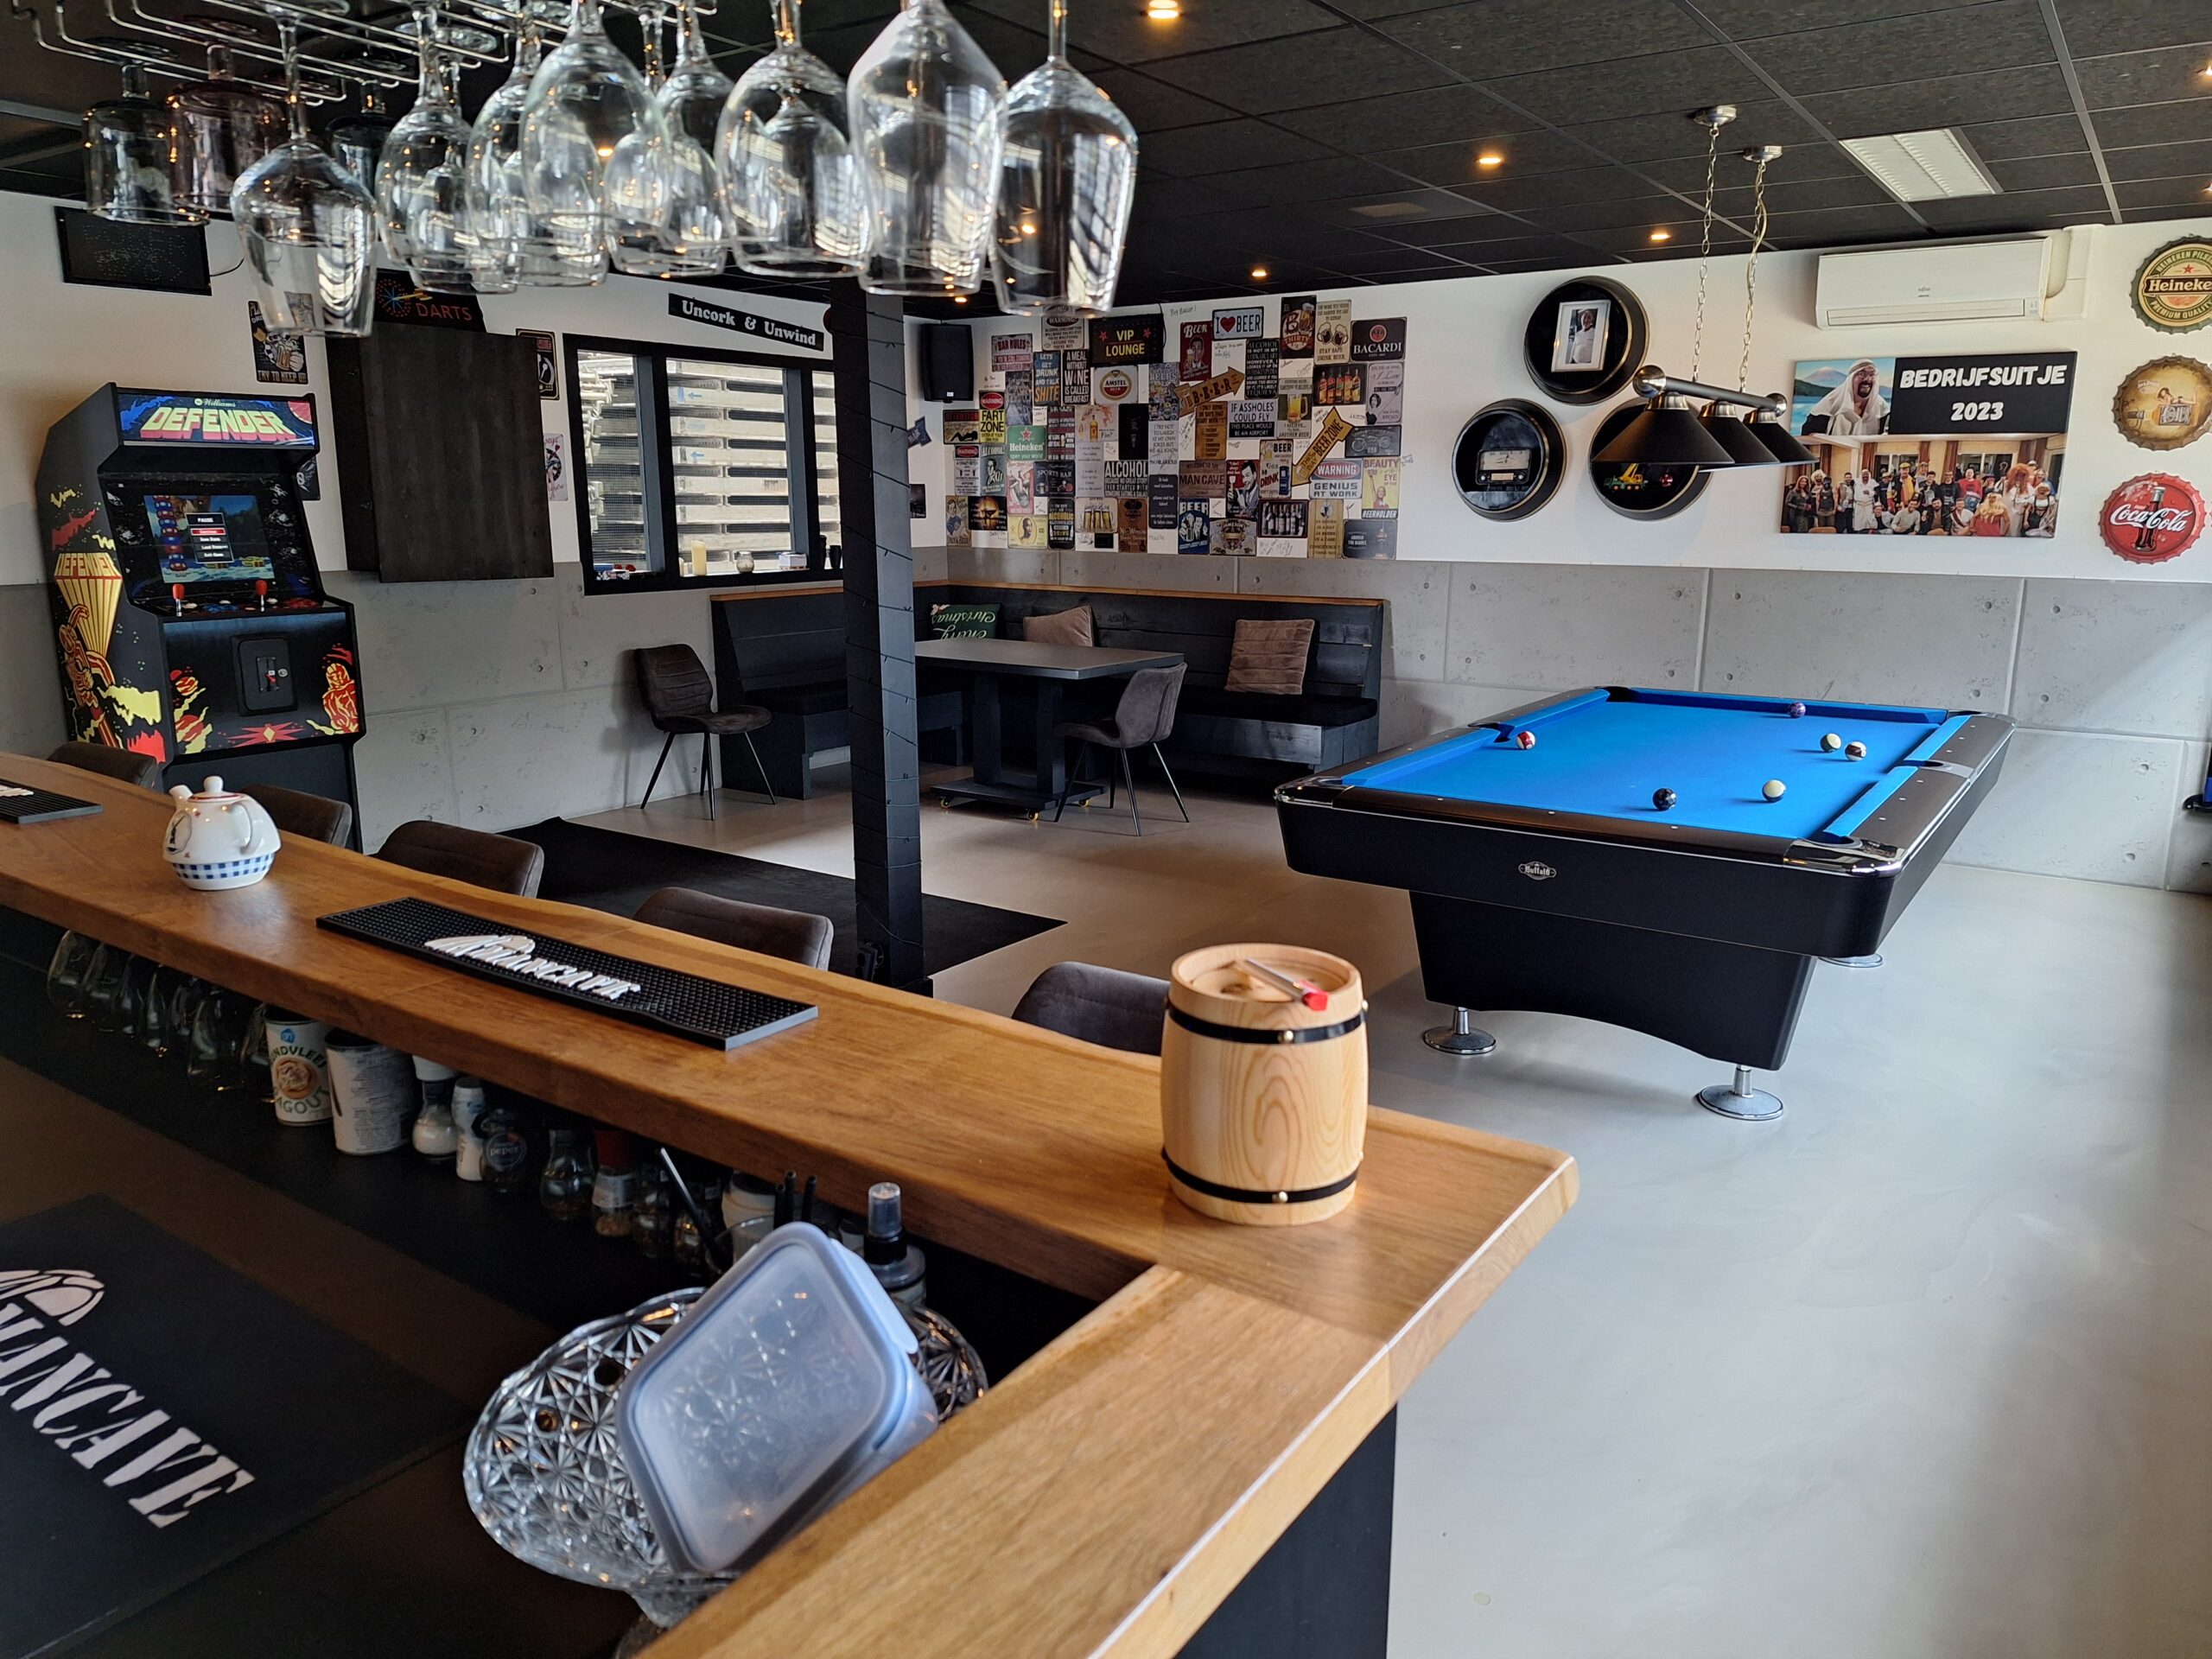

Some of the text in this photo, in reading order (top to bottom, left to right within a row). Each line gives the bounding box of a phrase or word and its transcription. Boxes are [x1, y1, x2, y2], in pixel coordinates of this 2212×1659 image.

[2156, 251, 2191, 272] HEINEKEN
[416, 302, 473, 321] DARTS
[2151, 300, 2212, 319] PREMIUM QUALITY
[682, 300, 817, 346] Uncork & Unwind
[1216, 314, 1261, 334] I BEER
[1116, 329, 1135, 341] VIP
[1184, 324, 1208, 338] BEER
[997, 339, 1027, 351] BAR RULES
[1106, 343, 1146, 357] LOUNGE
[1353, 342, 1402, 354] BACARDI
[1066, 350, 1087, 361] A MEAL
[1066, 361, 1087, 370] WITHOUT
[270, 371, 280, 381] TO
[280, 372, 297, 382] KEEP
[1035, 368, 1058, 378] DRUNK
[1899, 365, 2068, 389] BEDRIJFSUITJE
[1046, 378, 1059, 386] TALK
[1035, 385, 1060, 403] SHITE
[1065, 385, 1089, 395] IS CALLED
[202, 397, 237, 408] Williams
[1065, 395, 1090, 404] BREAKFAST
[1231, 402, 1274, 413] IF ASSHOLES
[1951, 401, 2004, 421] 2023
[982, 410, 1004, 421] FART
[1234, 412, 1271, 423] COULD FLY
[140, 406, 296, 441] DEFENDER
[981, 422, 1005, 433] ZONE
[1313, 418, 1344, 457] BEER ZONE
[1009, 442, 1044, 452] Heineken
[1273, 443, 1292, 453] BEER
[1300, 452, 1314, 467] THIS
[1306, 457, 1319, 471] WAY
[1363, 459, 1399, 468] BEAUTY
[1104, 461, 1148, 478] ALCOHOL
[1318, 464, 1357, 476] WARNING
[1180, 474, 1225, 485] MAN CAVE
[1260, 472, 1279, 488] DRINK
[1179, 501, 1209, 516] BEER
[1362, 510, 1397, 518] BEERHOLDER
[2110, 503, 2193, 532] Coca-Cola
[931, 611, 996, 625] Christmas
[1524, 863, 1550, 876] Buffalo
[489, 1145, 518, 1156] peper
